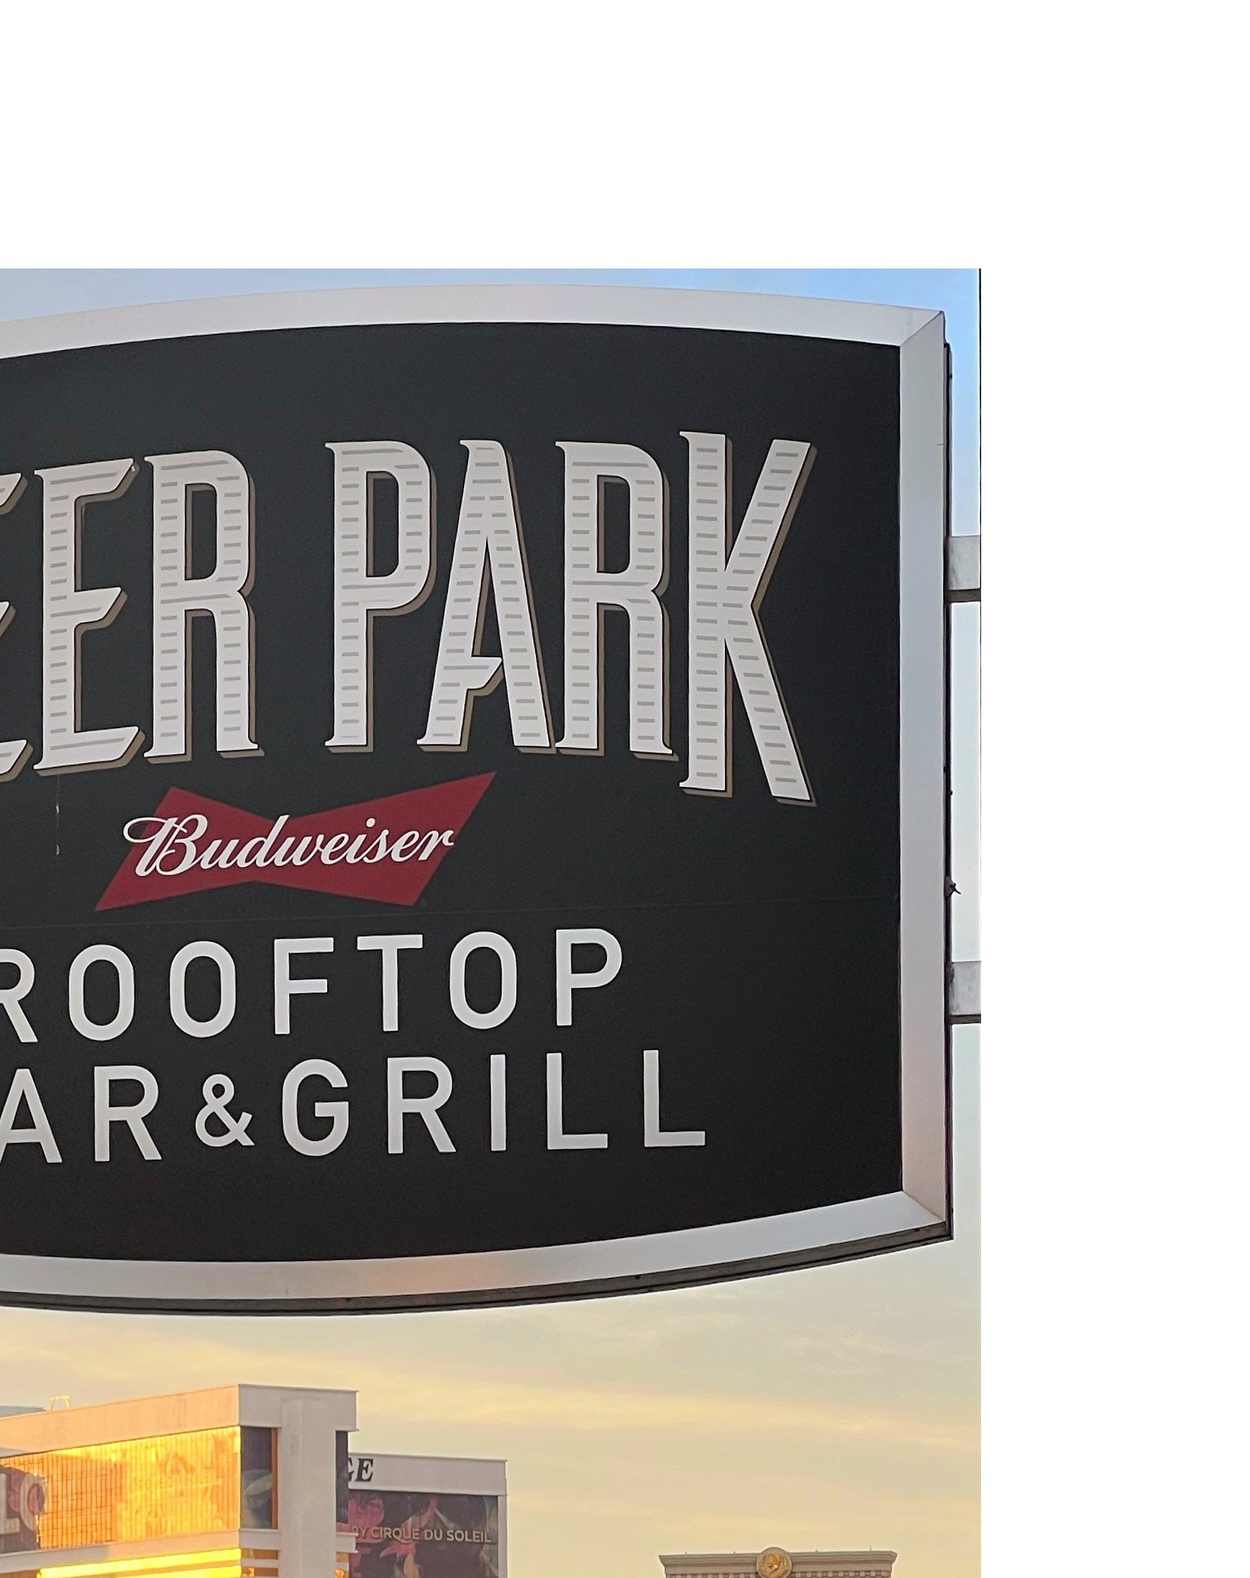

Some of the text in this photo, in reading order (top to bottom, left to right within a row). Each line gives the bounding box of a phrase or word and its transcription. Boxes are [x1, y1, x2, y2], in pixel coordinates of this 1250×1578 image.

[325, 431, 817, 806] PARK
[122, 813, 456, 878] Budweiser
[370, 1526, 421, 1544] CIRQUE
[424, 1527, 443, 1541] DU
[446, 1529, 492, 1543] SOLEIL
